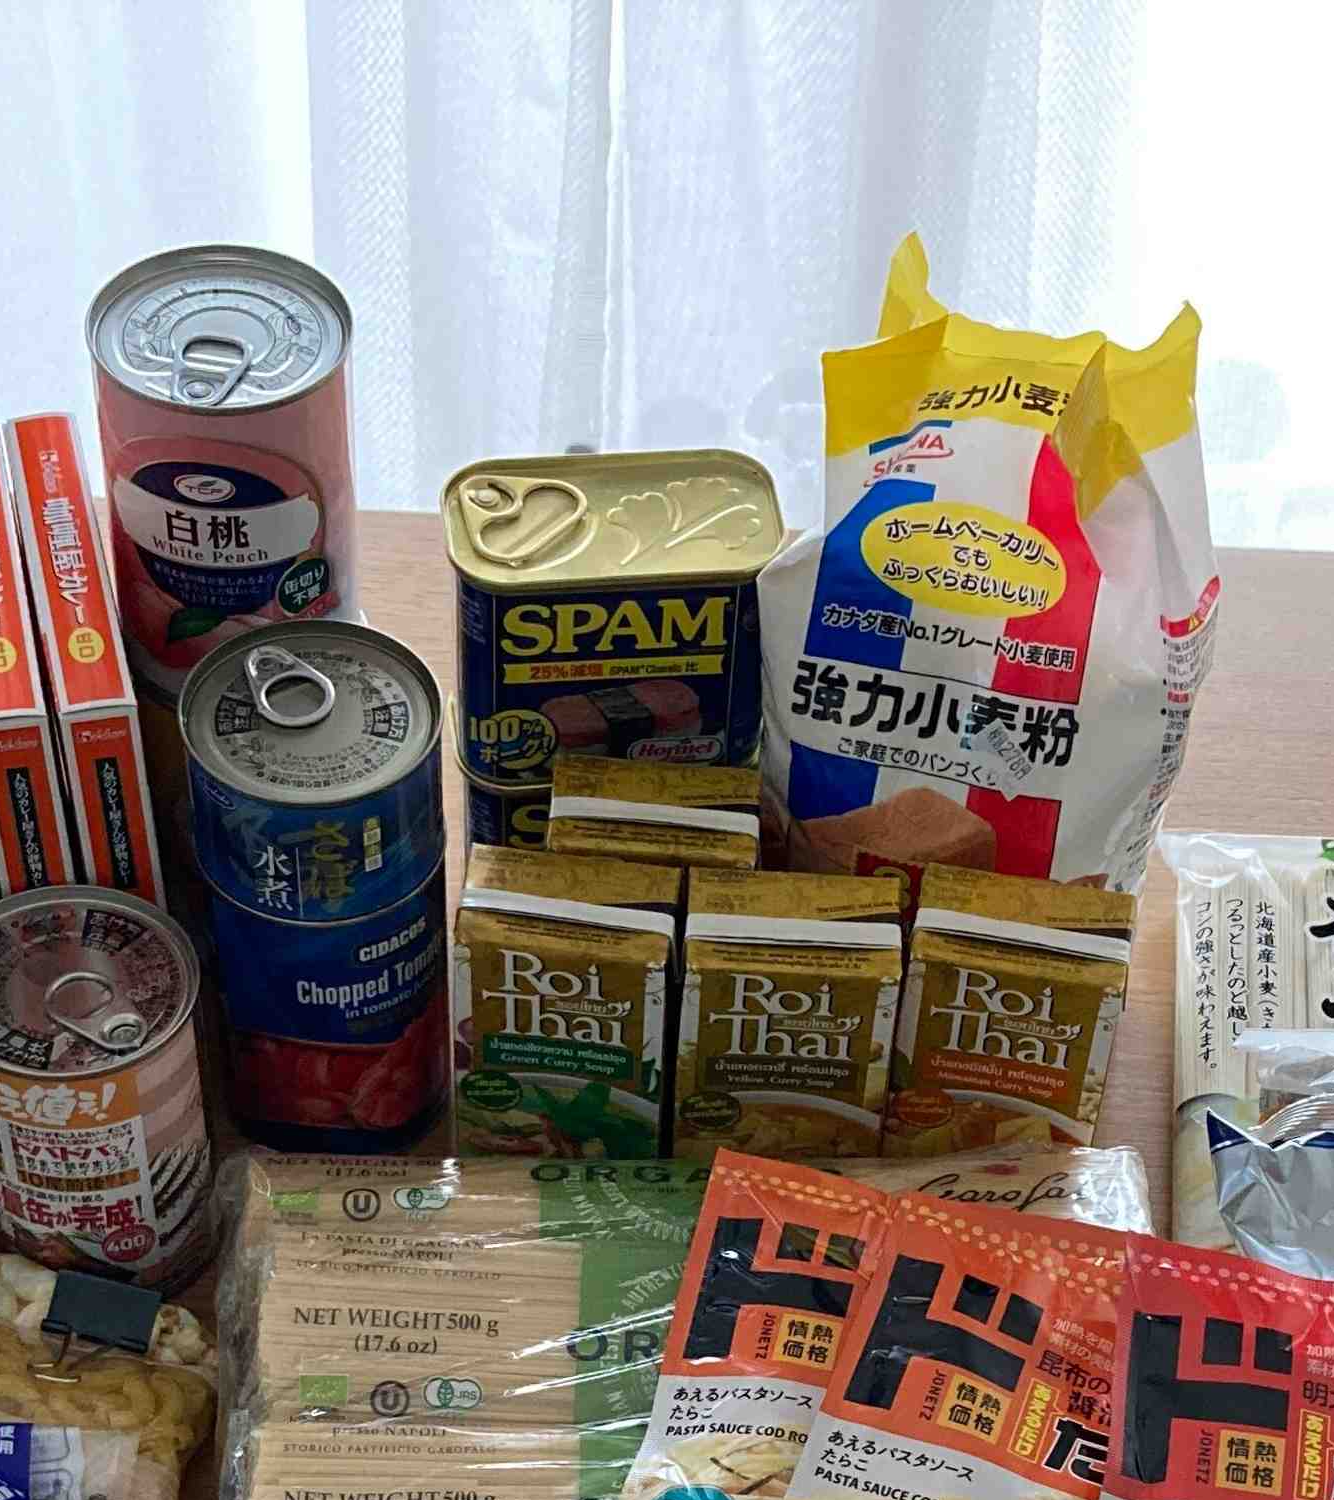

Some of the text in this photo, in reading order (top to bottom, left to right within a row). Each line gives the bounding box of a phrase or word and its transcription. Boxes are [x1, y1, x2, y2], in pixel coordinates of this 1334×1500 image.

[917, 375, 1071, 417] 強力小麦
[152, 535, 269, 564] White Peach
[165, 509, 251, 550] 白桃
[884, 515, 1059, 572] ホームベーカリー
[952, 544, 992, 570] でも
[881, 558, 1050, 611] ふっくらおいしい!
[500, 596, 731, 657] SPAM
[822, 603, 1078, 672] カナダ産No.1グレード小麦使用
[469, 713, 543, 742] 100%
[638, 740, 715, 759] Hormel
[252, 844, 294, 912] 水煮
[359, 915, 427, 963] CIDACOS
[497, 948, 605, 1001] Roi
[729, 972, 835, 1017] Roi
[951, 967, 1054, 1023] Roi
[293, 1306, 500, 1337] NET WEIGHT 500 g
[669, 1405, 714, 1421] たらこ
[819, 1448, 869, 1474] たらこ
[827, 1429, 977, 1483] あえるパスタソース
[1226, 1436, 1278, 1464] 情熱
[814, 1465, 859, 1491] PASTA
[1224, 1462, 1275, 1489] 価格
